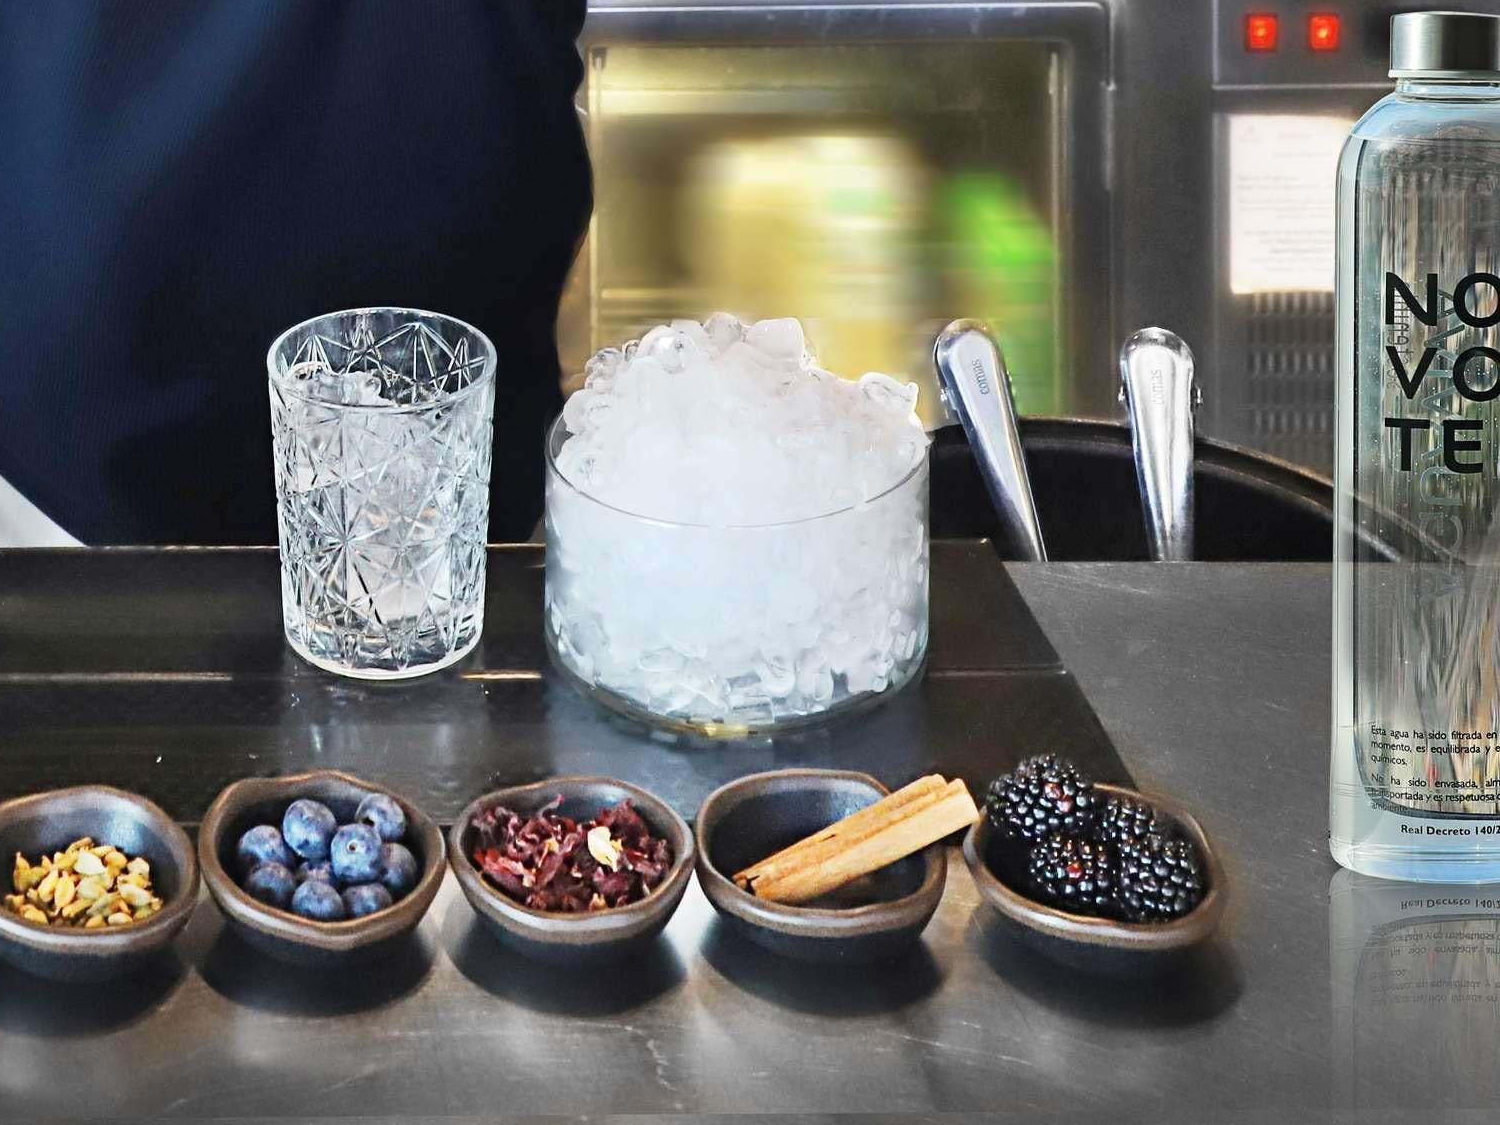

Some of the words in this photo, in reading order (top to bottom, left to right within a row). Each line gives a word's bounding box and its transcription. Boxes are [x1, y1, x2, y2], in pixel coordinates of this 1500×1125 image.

[1371, 725, 1386, 736] Esta
[1390, 730, 1409, 740] agua
[1413, 730, 1424, 739] ha
[1429, 731, 1447, 740] sido
[1451, 730, 1482, 740] filtrada
[1415, 745, 1426, 753] es
[1431, 743, 1481, 755] equilibrada
[1390, 775, 1401, 785] ha
[1408, 776, 1427, 787] sido
[1371, 787, 1424, 801] transportada
[1445, 793, 1495, 803] respetuosa
[1401, 824, 1423, 835] Real
[1426, 826, 1471, 836] Decreto
